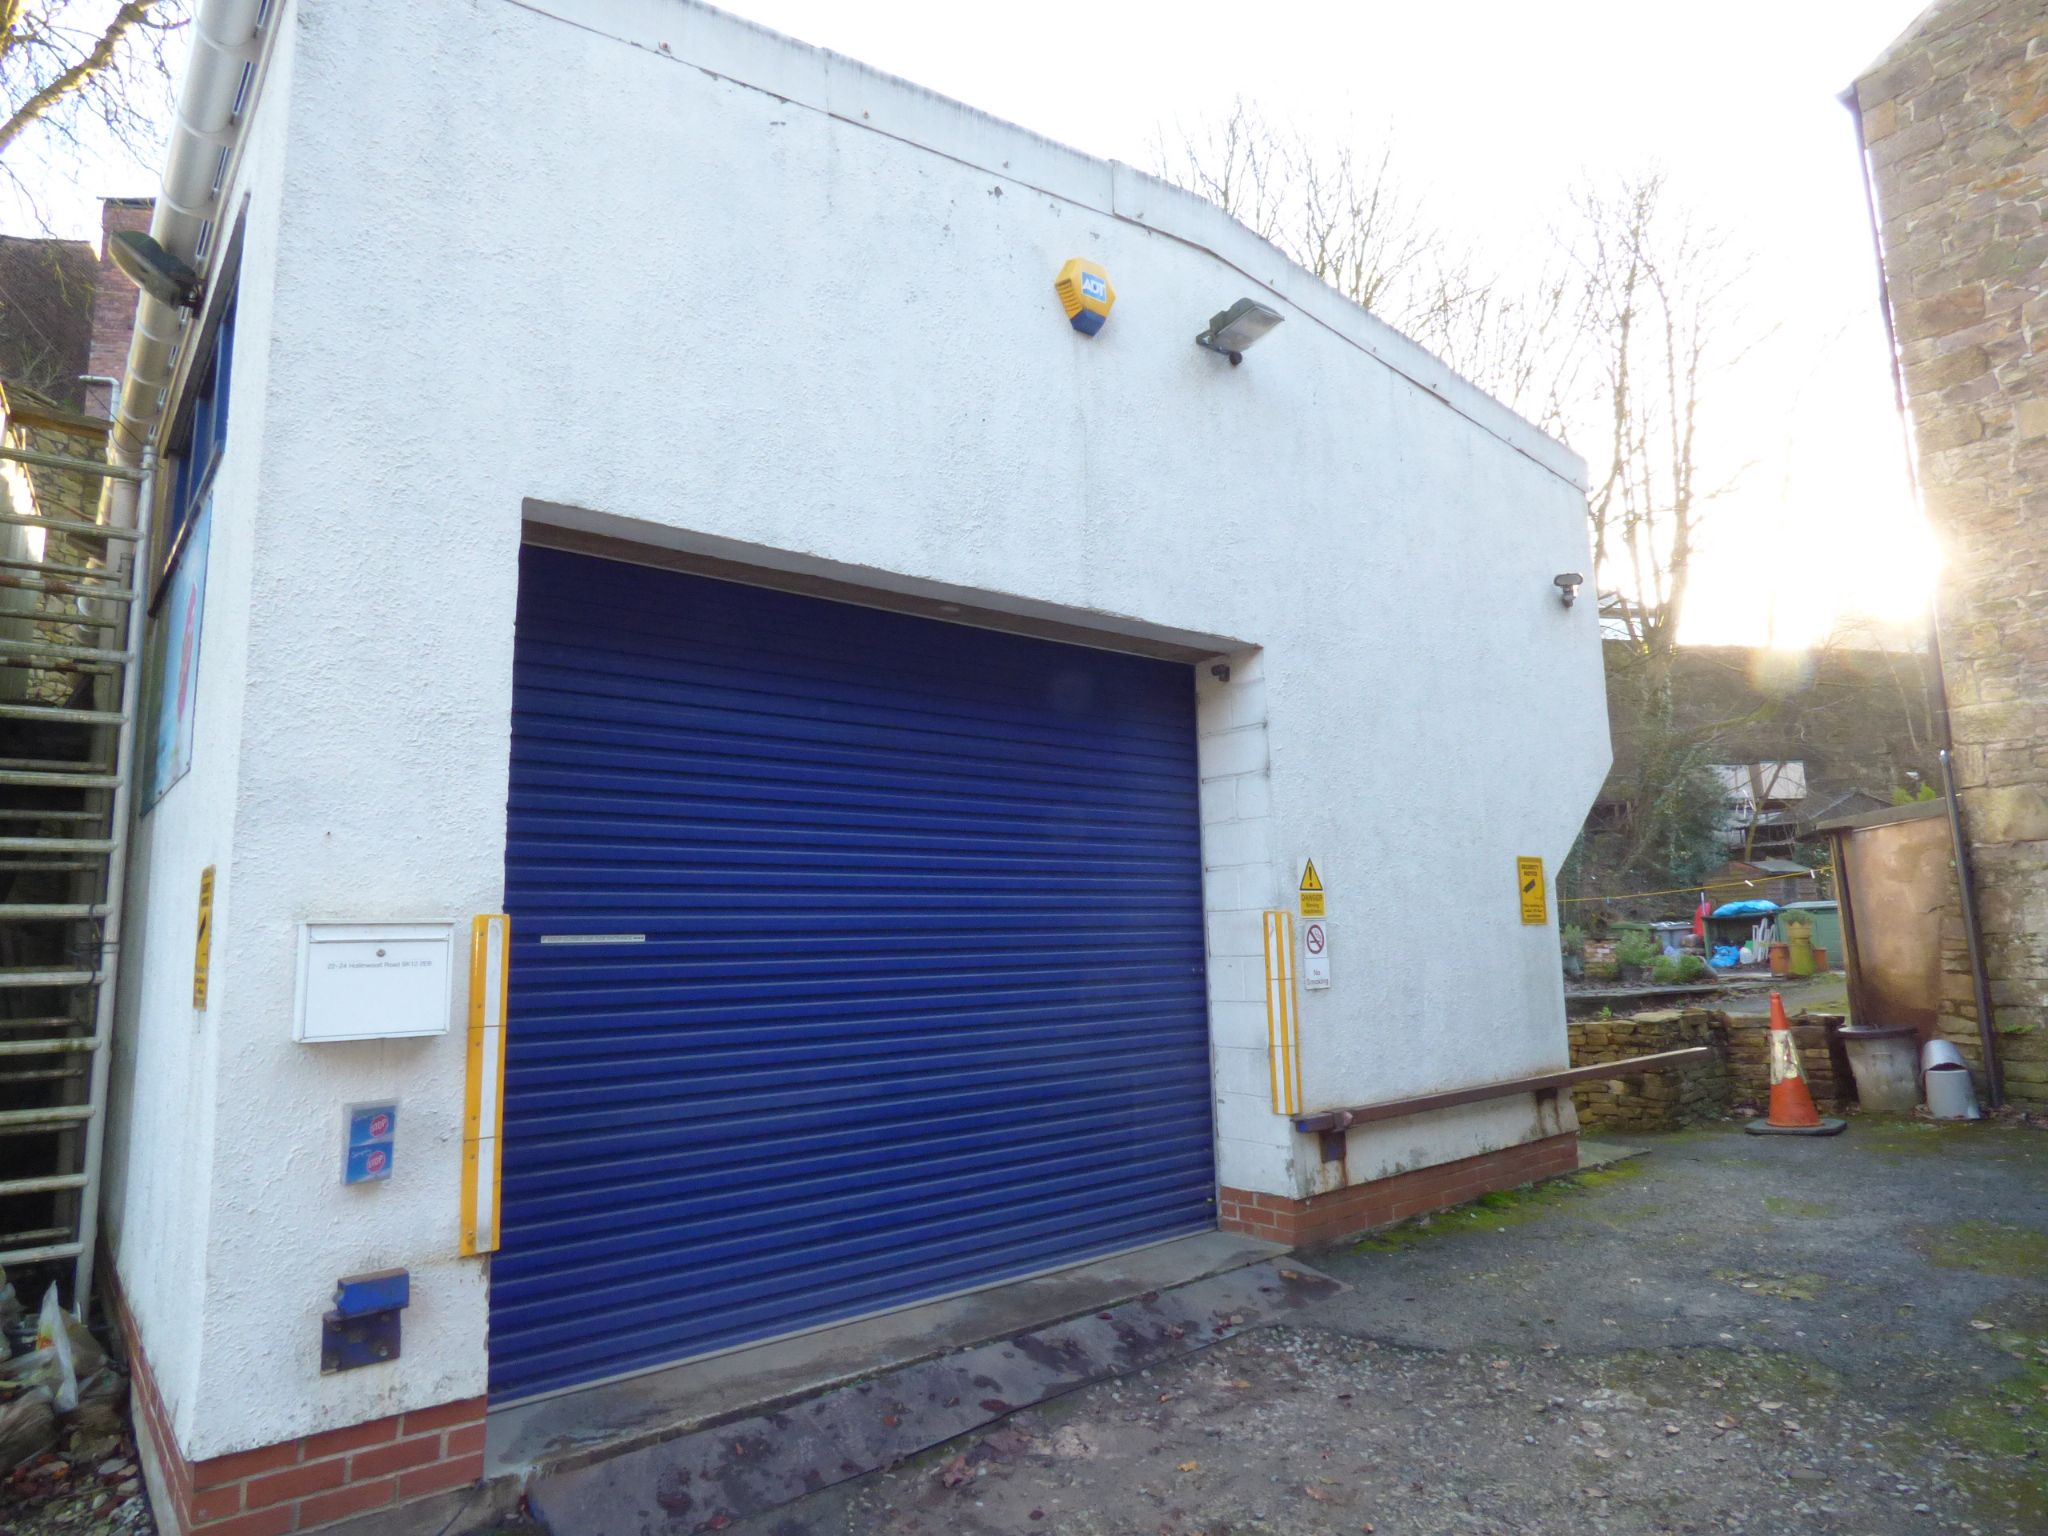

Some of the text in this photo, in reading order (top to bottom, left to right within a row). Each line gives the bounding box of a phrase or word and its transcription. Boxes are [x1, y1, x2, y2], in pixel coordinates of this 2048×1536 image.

[1082, 278, 1105, 297] ADT
[1301, 894, 1323, 902] DANGER
[1313, 968, 1321, 977] No
[1306, 978, 1329, 986] Smoking
[371, 1118, 387, 1131] STOP
[367, 1154, 384, 1169] STOP
